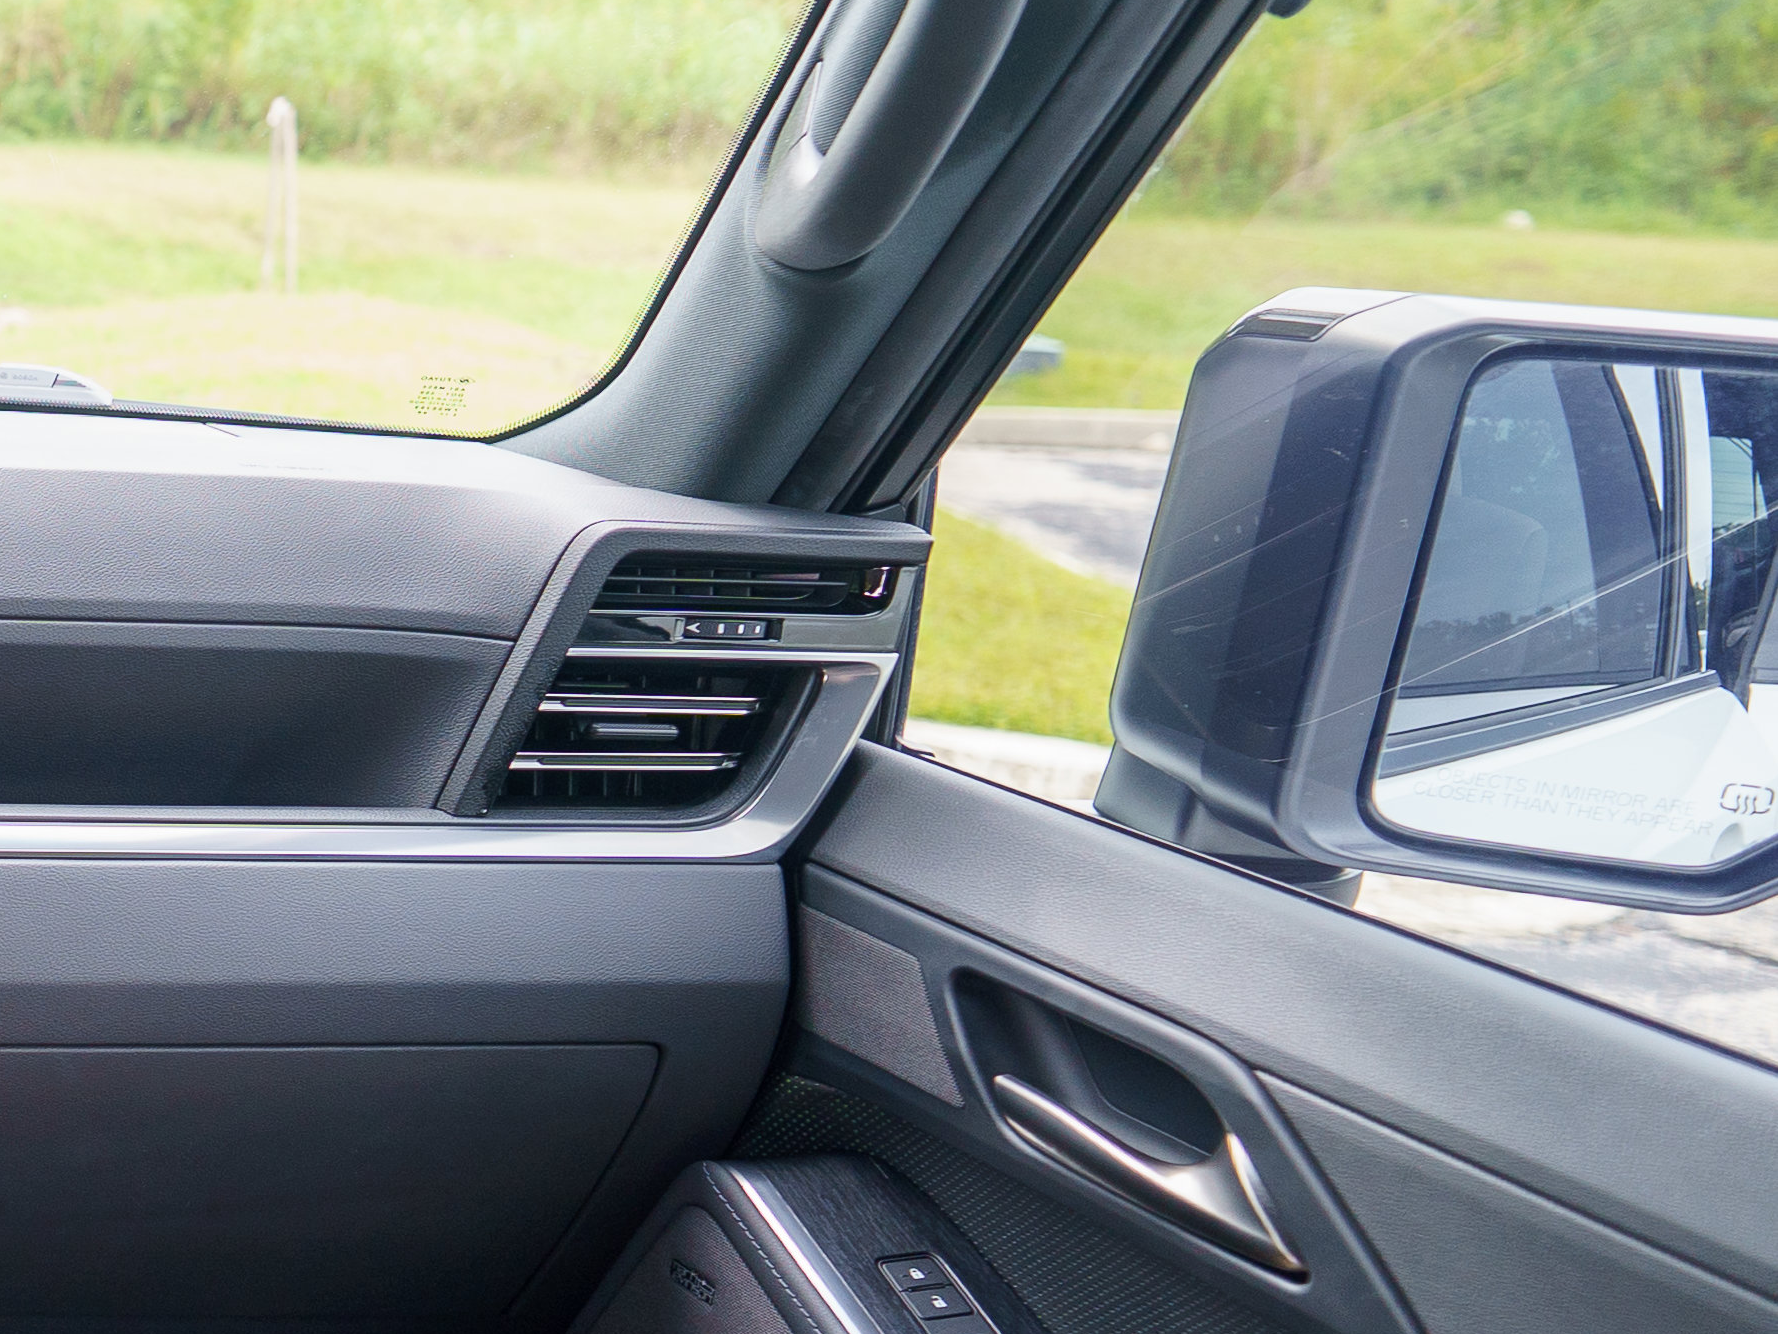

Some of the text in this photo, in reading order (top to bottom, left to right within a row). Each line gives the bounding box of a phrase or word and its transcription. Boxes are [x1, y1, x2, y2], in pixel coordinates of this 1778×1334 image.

[1414, 781, 1715, 836] CLOSER THAN THEY APPEAR
[1437, 767, 1699, 817] OBJECTS IN MIRROR ARE
